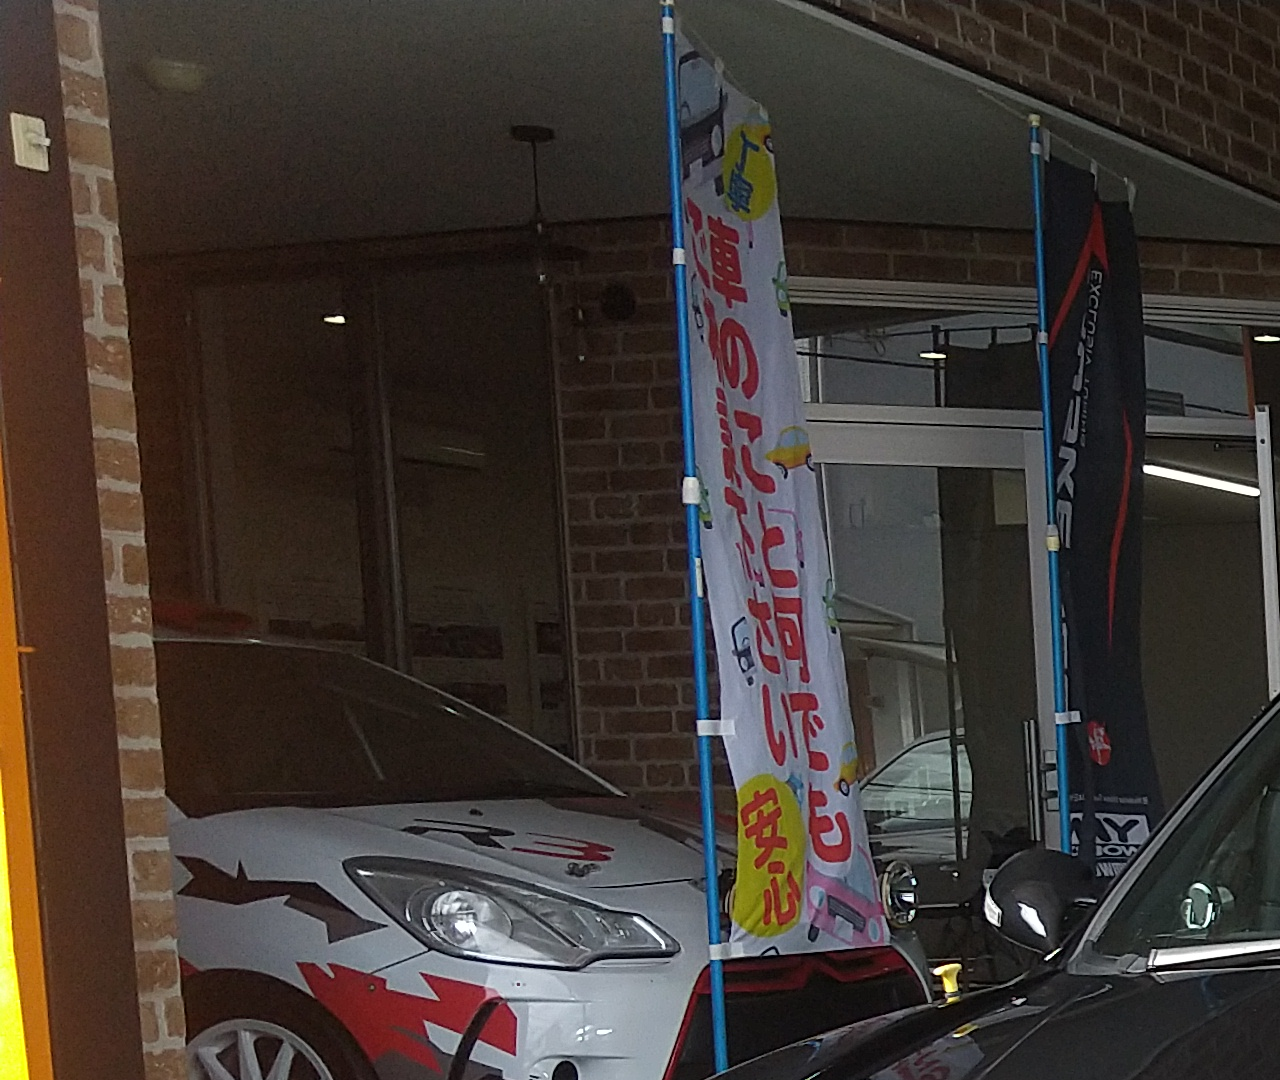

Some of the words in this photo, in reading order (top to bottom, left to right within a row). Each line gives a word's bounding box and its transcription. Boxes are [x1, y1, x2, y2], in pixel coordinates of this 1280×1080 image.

[686, 197, 799, 767] ご下さい
[707, 214, 852, 863] 車のこと何でも
[740, 787, 801, 927] 安心
